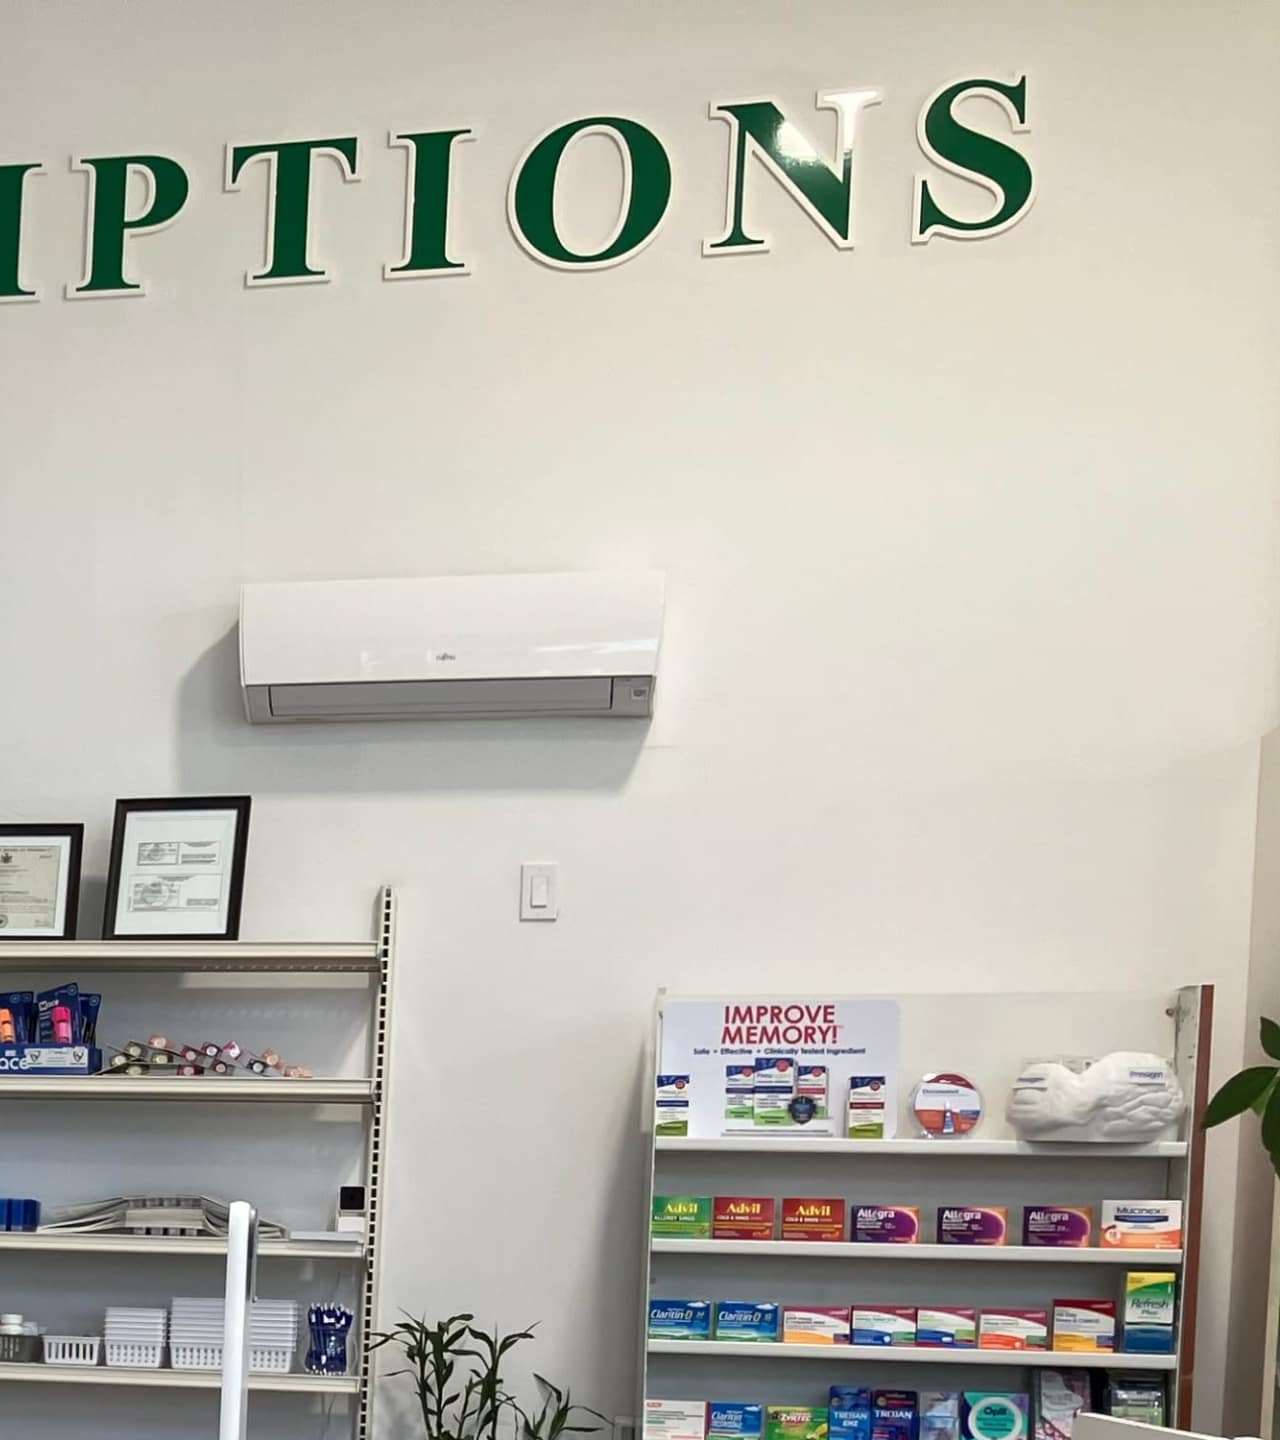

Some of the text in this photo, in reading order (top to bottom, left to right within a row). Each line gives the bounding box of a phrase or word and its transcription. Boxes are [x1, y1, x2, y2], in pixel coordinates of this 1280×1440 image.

[723, 1004, 835, 1024] IMPROVE
[720, 1026, 838, 1045] MEMORY!
[663, 1201, 698, 1215] Advil
[726, 1201, 761, 1215] Advil
[795, 1202, 831, 1217] Advil
